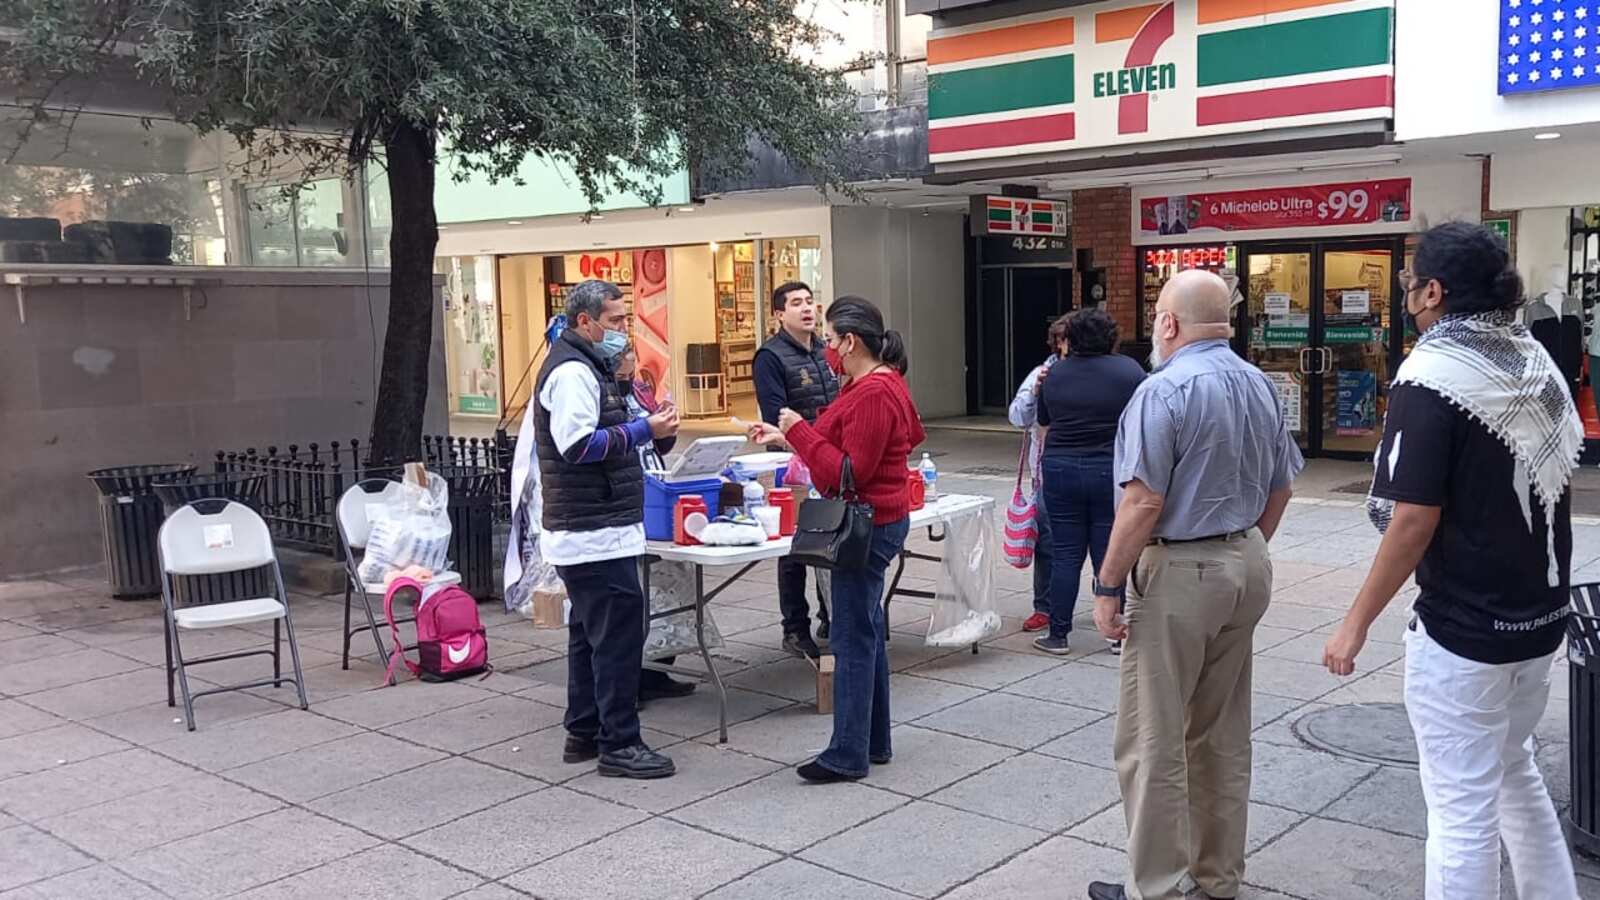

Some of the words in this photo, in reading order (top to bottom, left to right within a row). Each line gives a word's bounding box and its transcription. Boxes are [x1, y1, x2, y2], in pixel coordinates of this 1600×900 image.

[1095, 1, 1175, 135] 7
[1210, 203, 1219, 215] 6
[1221, 199, 1279, 214] Michelob
[1281, 197, 1313, 211] Ultra
[1318, 189, 1369, 219] $99
[1012, 236, 1047, 250] 432
[1325, 330, 1369, 339] Bienvenido
